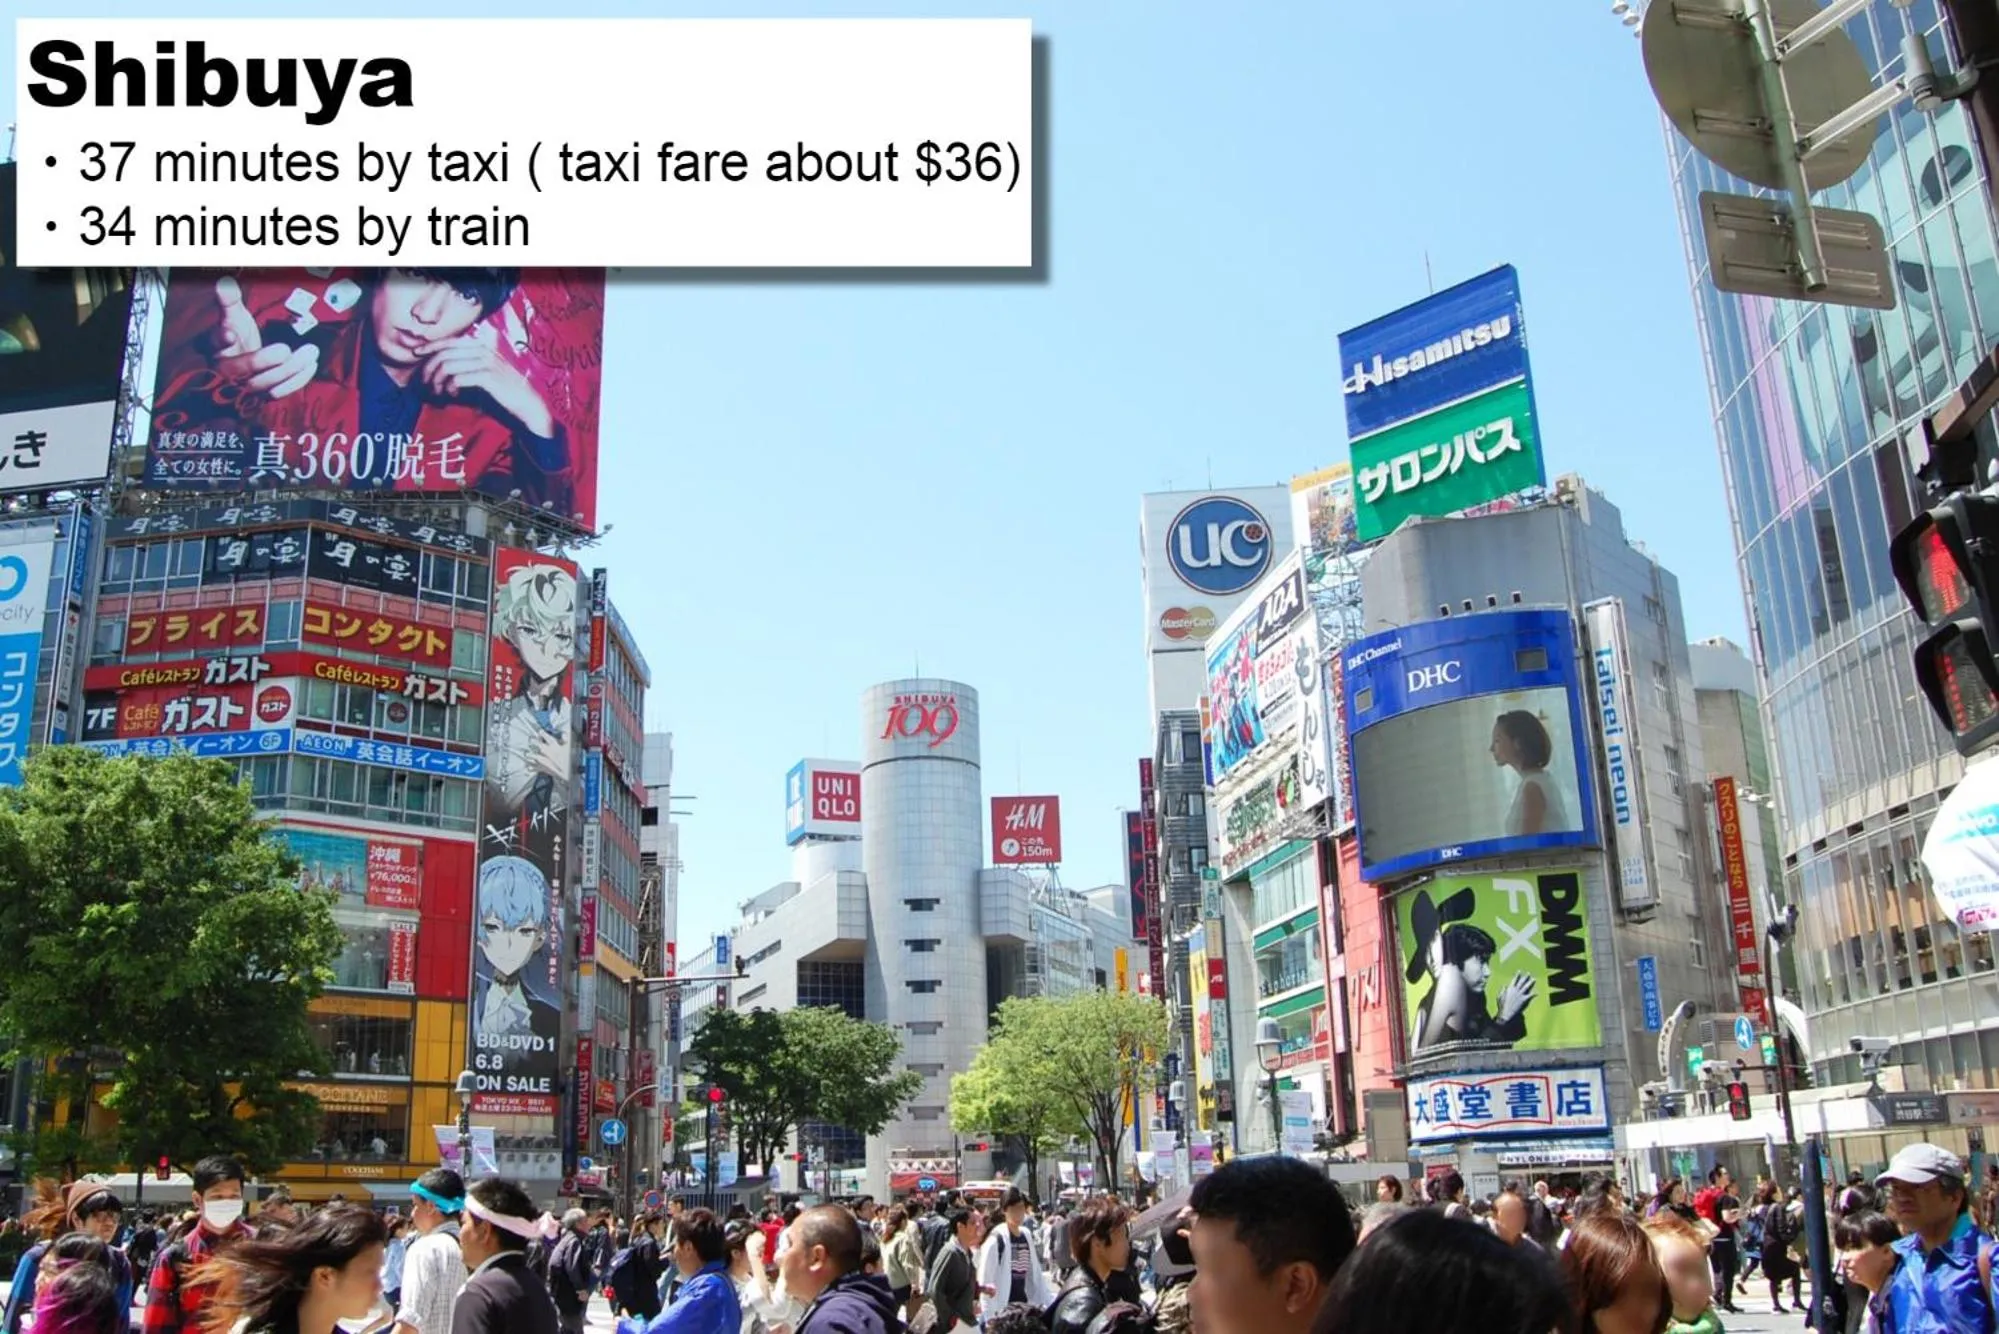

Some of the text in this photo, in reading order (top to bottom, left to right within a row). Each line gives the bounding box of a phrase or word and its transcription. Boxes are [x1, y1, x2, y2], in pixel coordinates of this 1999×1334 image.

[1343, 314, 1511, 394] Hisamitsu
[1357, 416, 1521, 504] サロンパス
[129, 609, 262, 646] プライス
[304, 606, 447, 657] コンタクト
[1161, 615, 1216, 629] MasterCard
[204, 655, 270, 685] ガスト
[1407, 660, 1463, 693] DHC
[403, 673, 469, 705] ガスト
[87, 707, 117, 730] 7F
[124, 704, 159, 720] Café
[161, 696, 244, 733] ガスト
[880, 703, 959, 748] 109
[302, 735, 346, 752] AEON
[357, 740, 481, 774] 英会話イーオン
[818, 777, 852, 795] UNI
[1607, 744, 1631, 825] neon
[817, 799, 855, 818] QLO
[1005, 803, 1046, 831] H&M
[1021, 845, 1053, 857] 150m
[1441, 846, 1463, 858] DHC
[1492, 878, 1542, 964] FX
[1537, 872, 1591, 1008] DMM
[476, 1033, 555, 1052] BD&DVD 1
[475, 1054, 504, 1070] 6.8
[476, 1075, 551, 1093] ON SALE
[1415, 1079, 1593, 1125] 大盛堂書店
